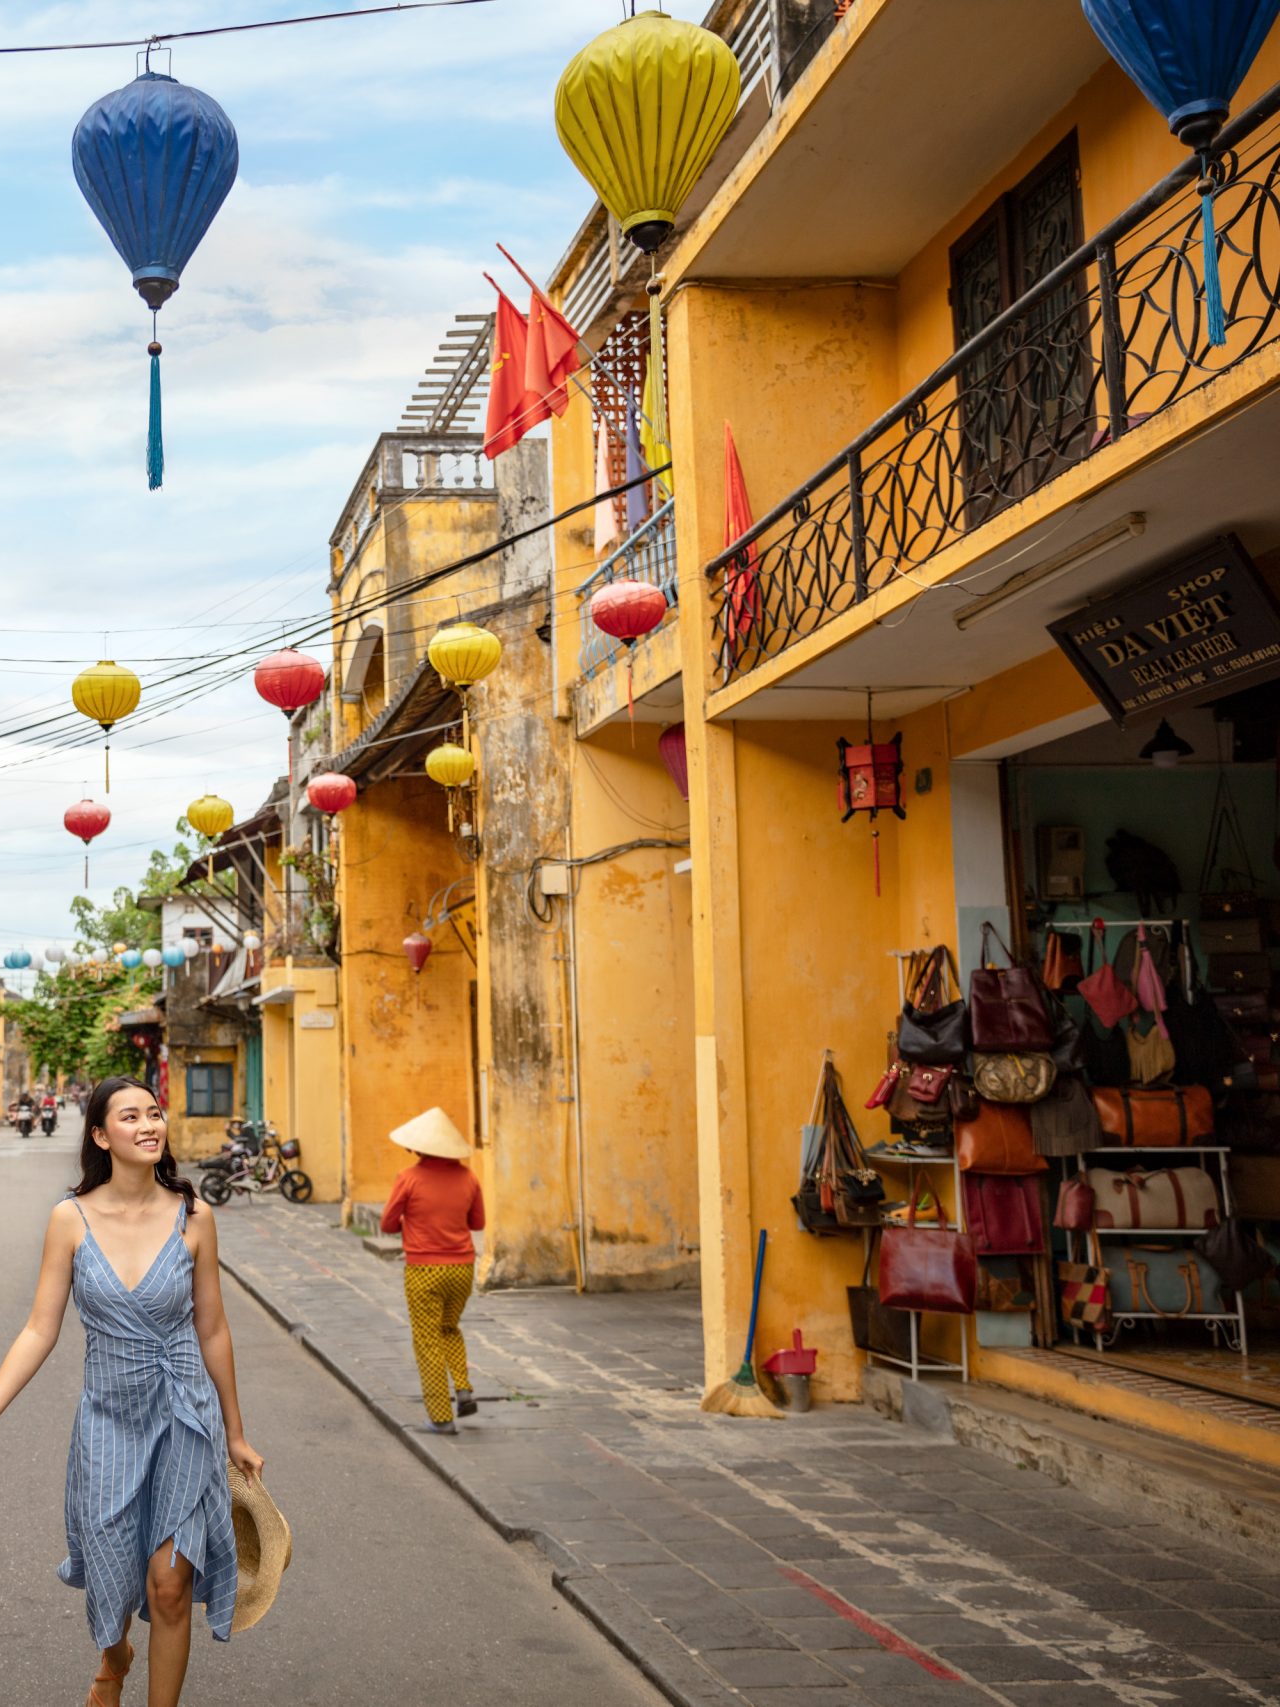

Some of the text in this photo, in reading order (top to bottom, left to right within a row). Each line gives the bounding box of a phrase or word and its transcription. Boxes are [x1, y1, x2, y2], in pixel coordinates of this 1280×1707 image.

[1167, 567, 1227, 601] SHOP
[1096, 595, 1231, 669] DA VIỆT
[1130, 631, 1238, 687] REAL LEATHER
